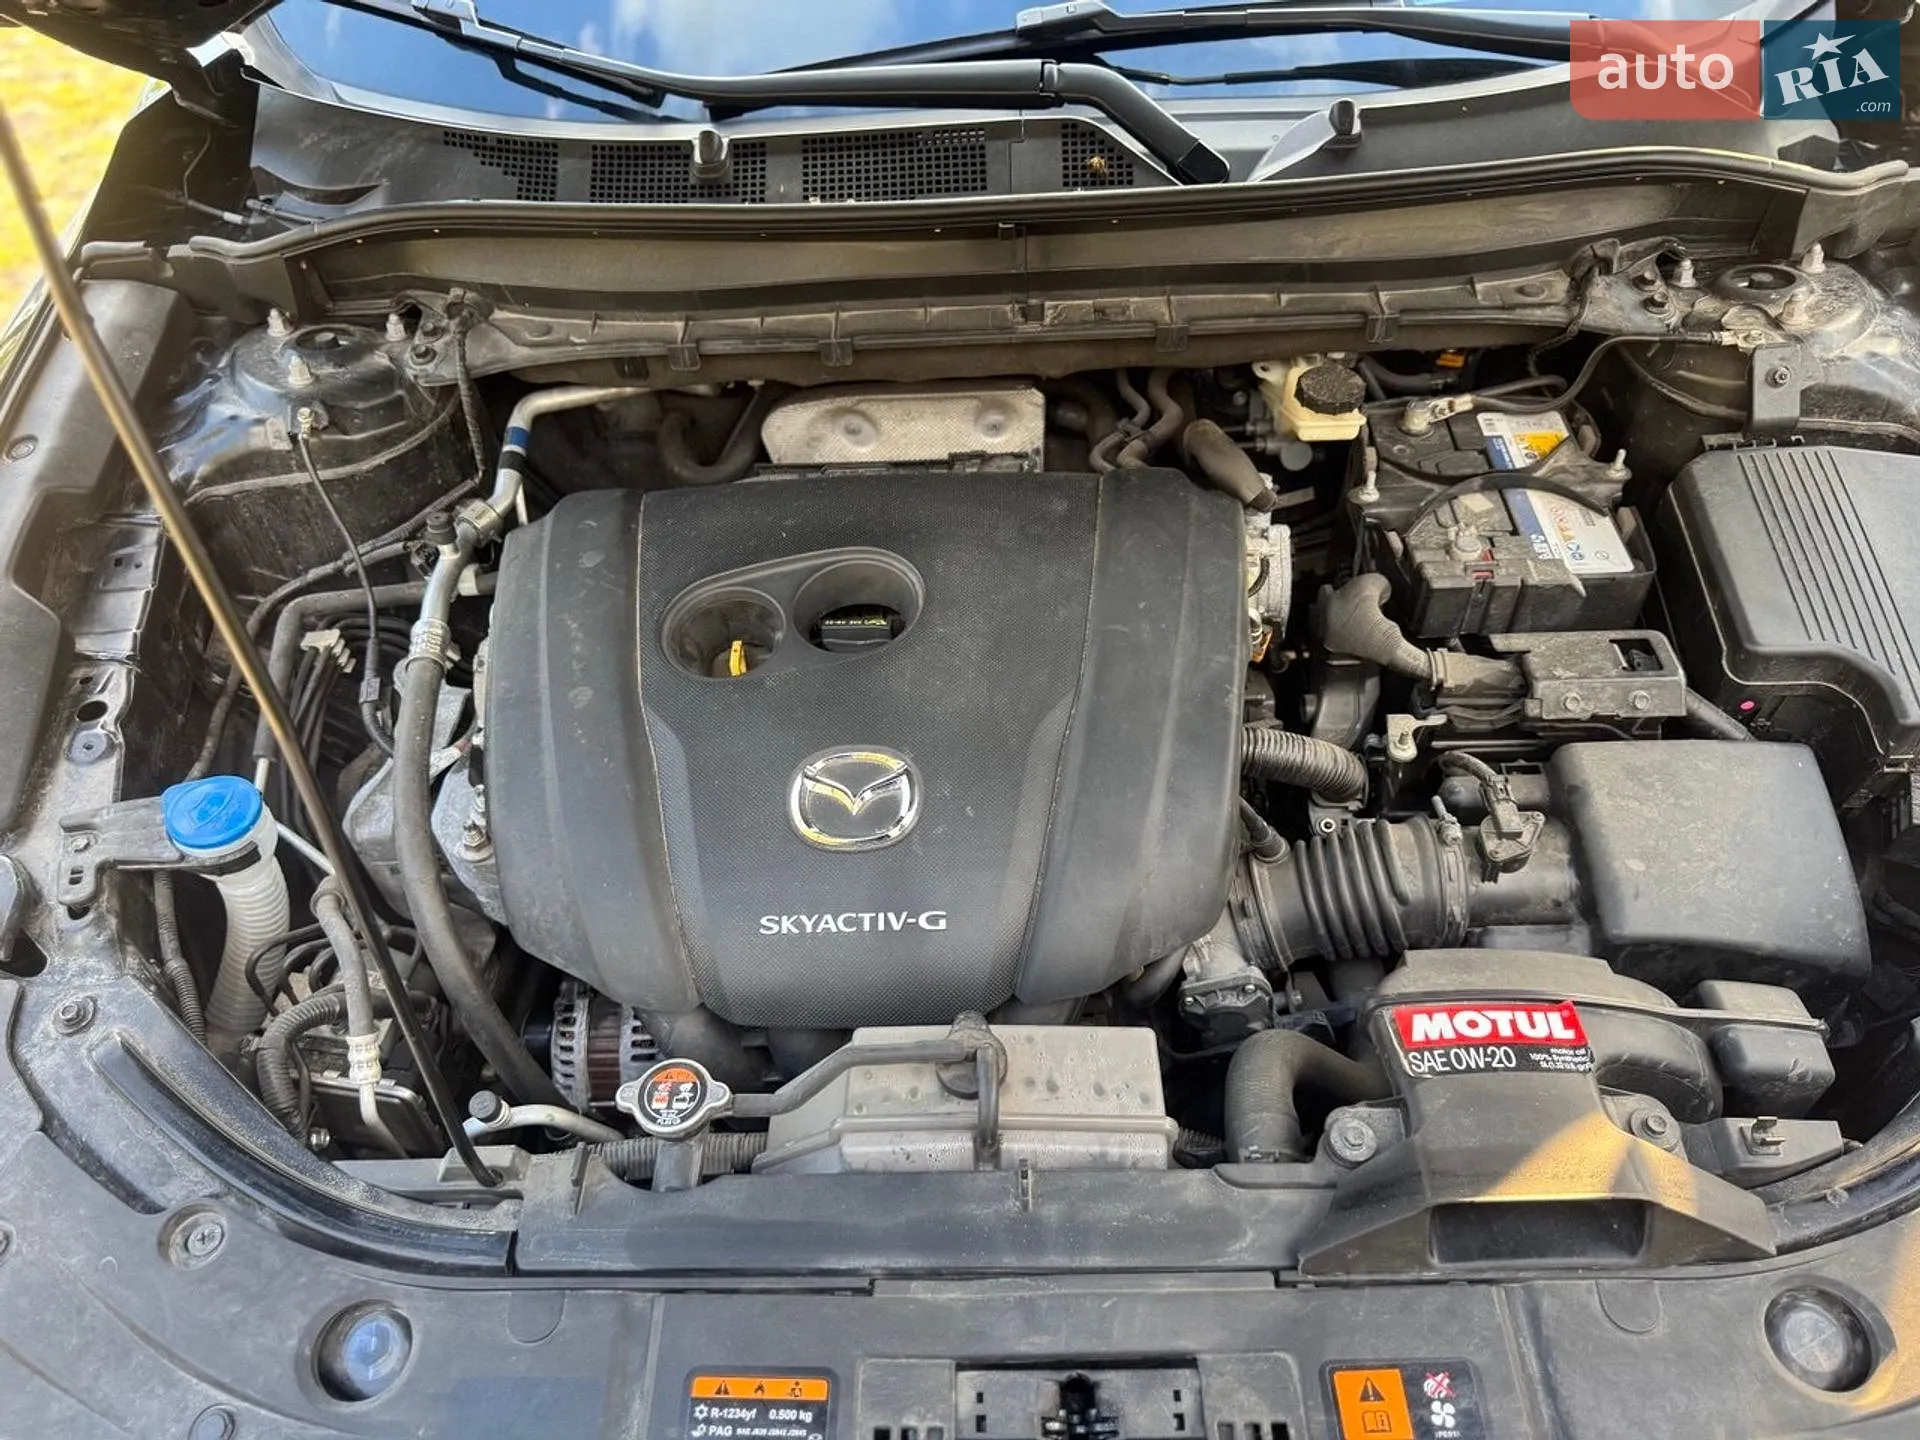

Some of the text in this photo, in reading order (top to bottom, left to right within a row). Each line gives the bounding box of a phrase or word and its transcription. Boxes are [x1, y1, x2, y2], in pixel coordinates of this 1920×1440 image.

[759, 910, 947, 935] SKYACTIV-G
[1411, 1009, 1576, 1042] MOTUL
[1408, 1050, 1451, 1073] SAE
[1451, 1046, 1517, 1070] 0W-20
[710, 1407, 813, 1423] R-1234yf 0.500 kg
[709, 1425, 733, 1437] PAG
